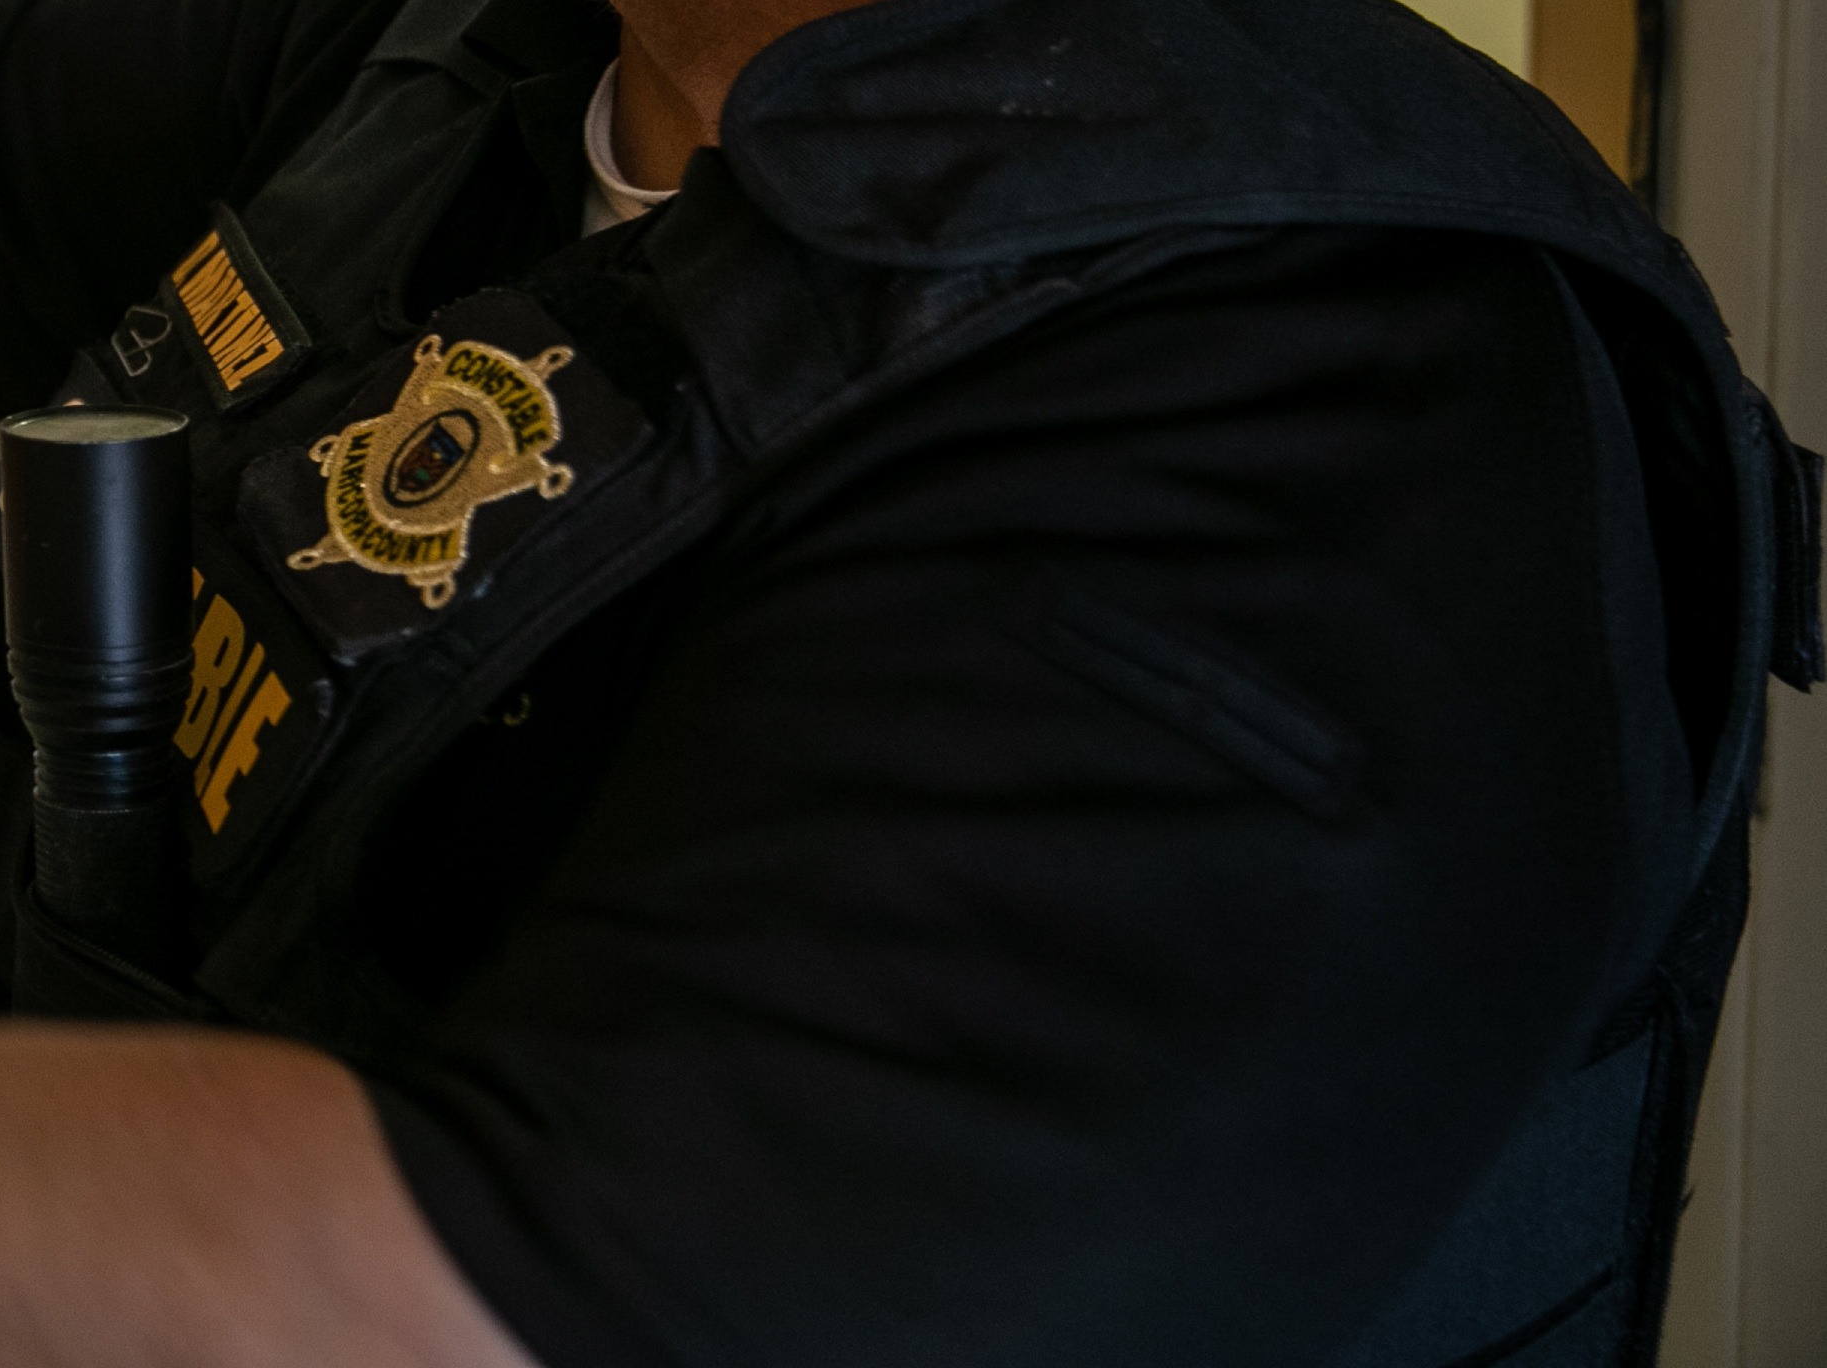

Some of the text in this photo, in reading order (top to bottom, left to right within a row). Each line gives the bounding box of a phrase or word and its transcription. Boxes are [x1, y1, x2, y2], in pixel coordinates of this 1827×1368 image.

[177, 246, 285, 392] MARTINEZ
[445, 348, 549, 457] CONSTABLE
[359, 528, 452, 562] COUNTY
[173, 566, 293, 835] BLE
